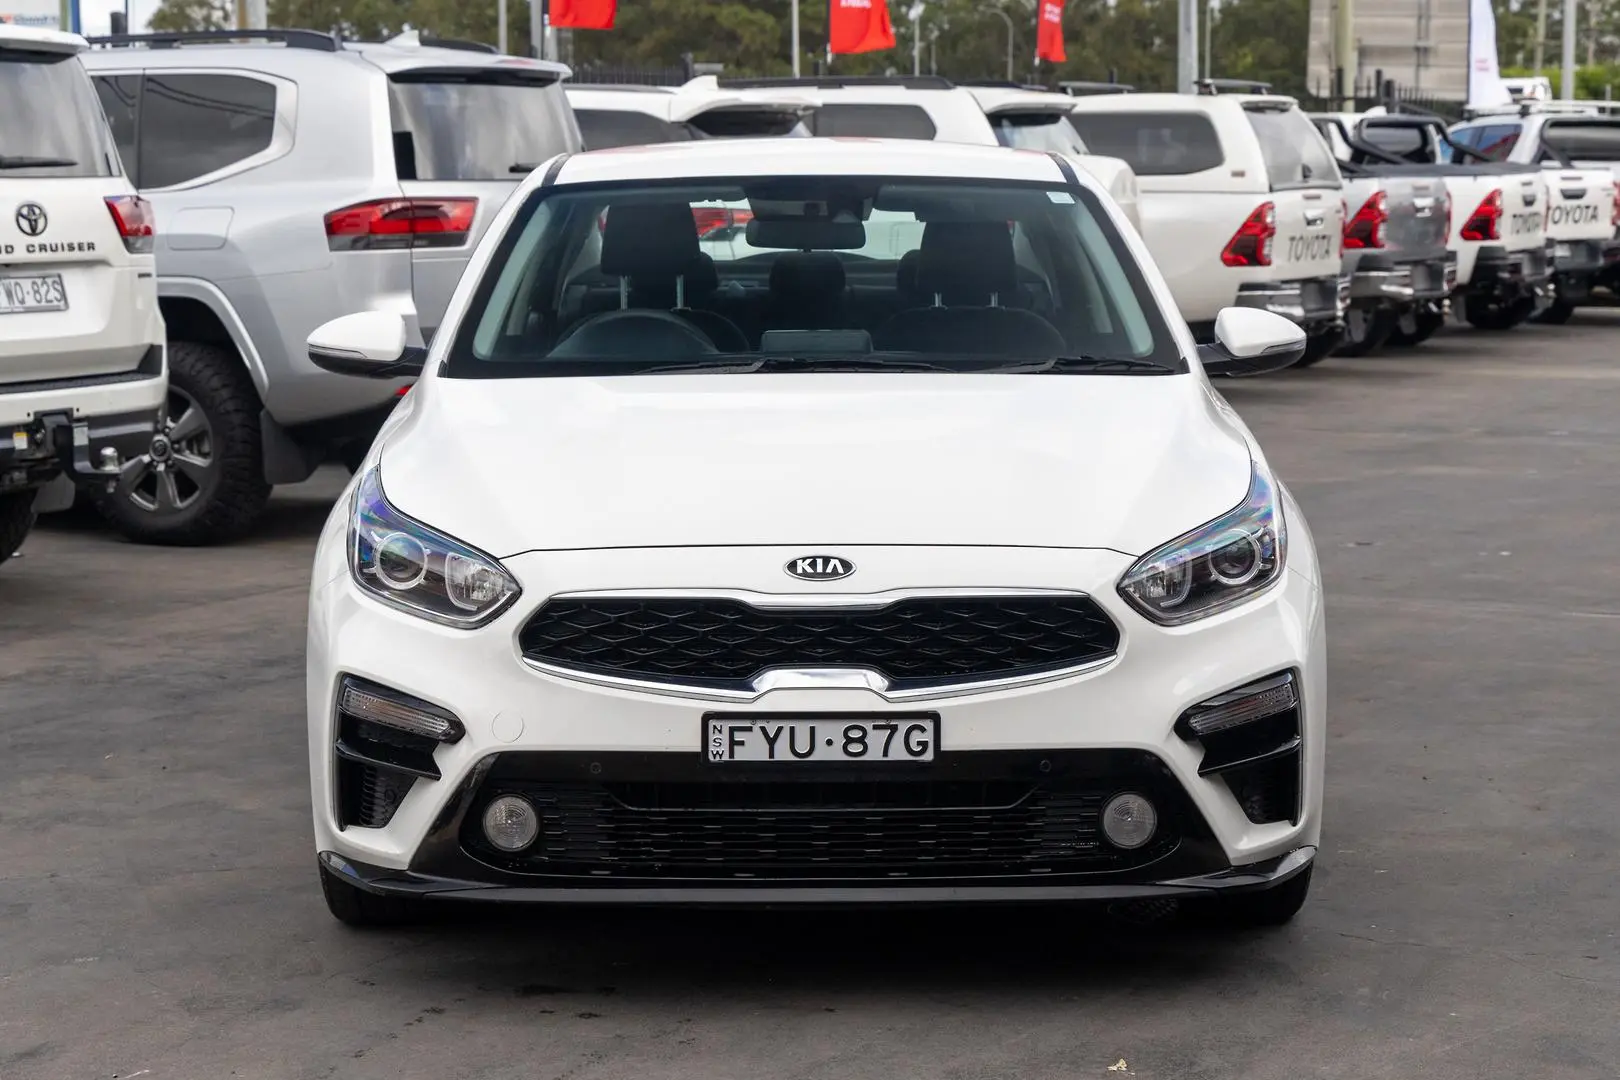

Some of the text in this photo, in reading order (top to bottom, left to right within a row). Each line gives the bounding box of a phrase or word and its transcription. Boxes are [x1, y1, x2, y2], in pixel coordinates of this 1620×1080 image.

[1546, 205, 1598, 225] OYOTA
[0, 242, 96, 254] D CRUISER
[796, 558, 844, 574] KIA
